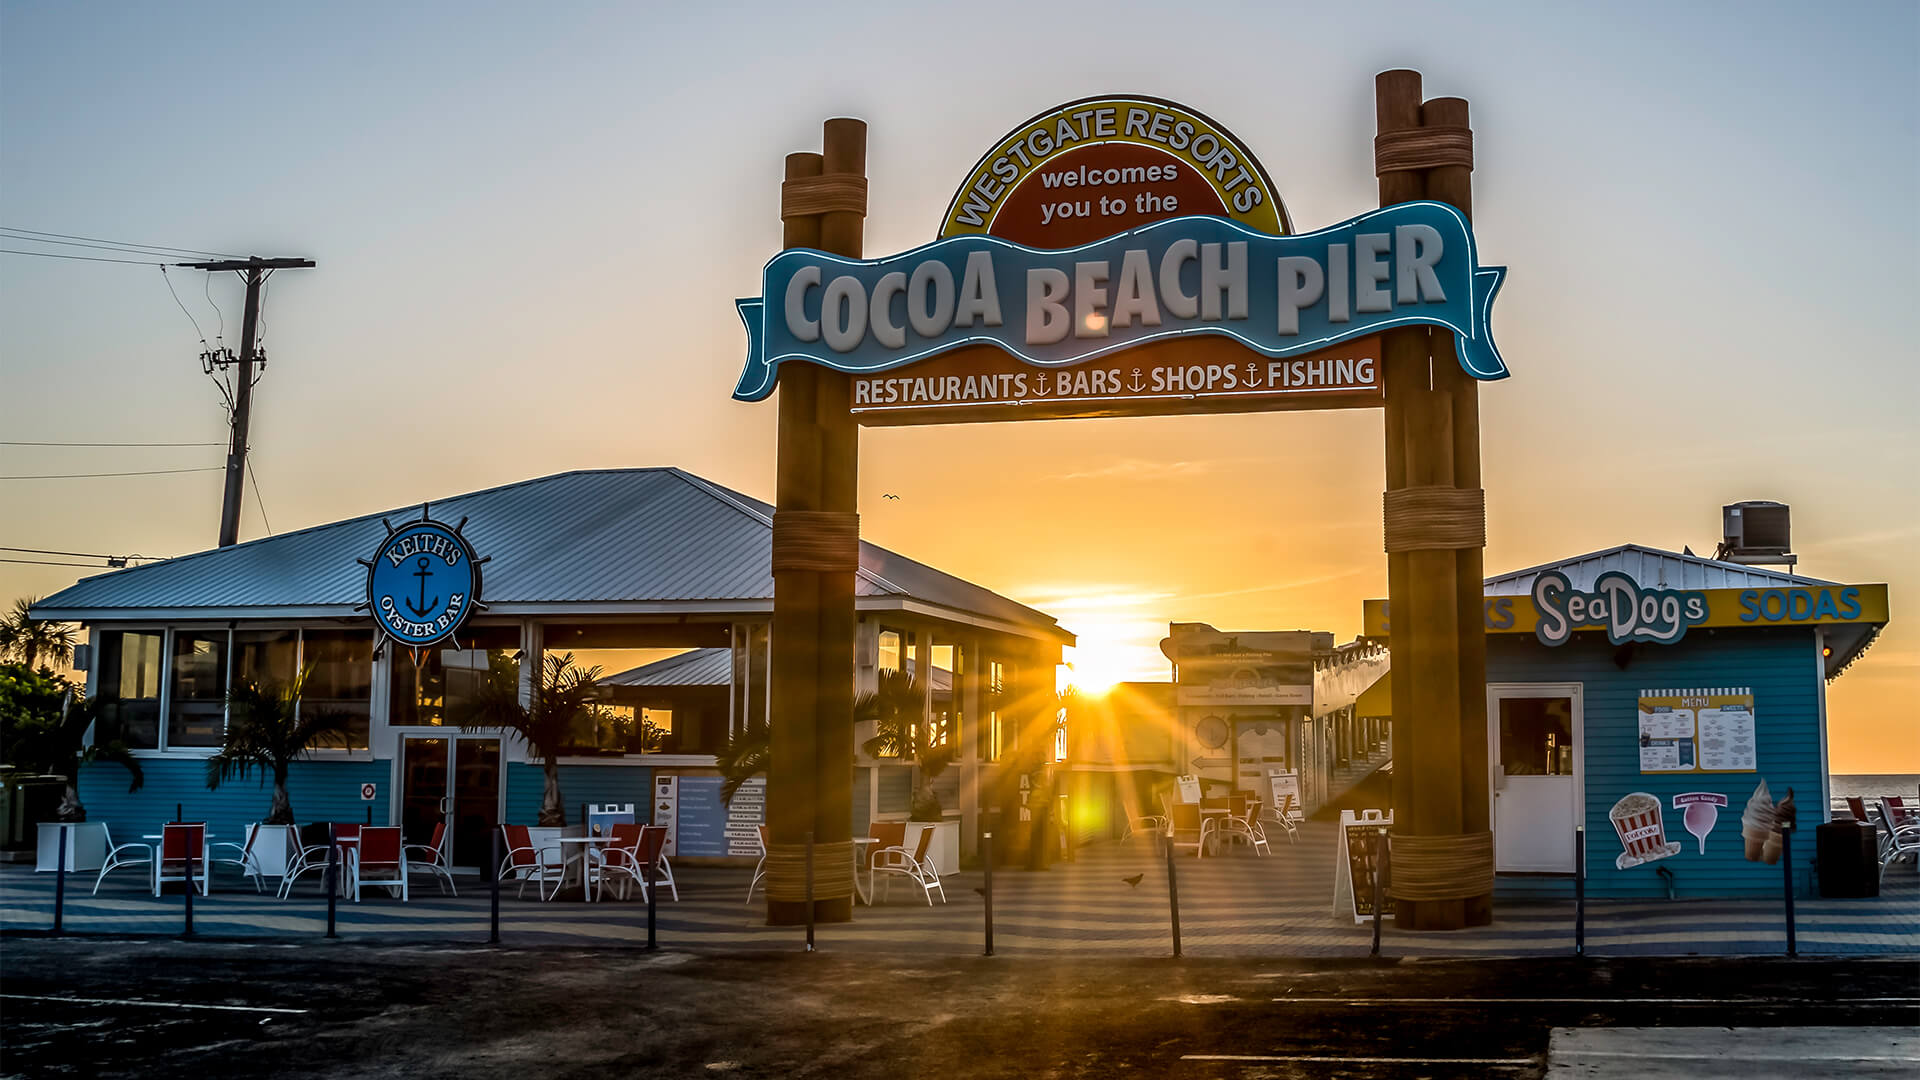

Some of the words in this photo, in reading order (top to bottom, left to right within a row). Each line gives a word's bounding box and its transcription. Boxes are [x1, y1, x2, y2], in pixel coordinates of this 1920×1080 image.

[955, 108, 1116, 227] WESTGATE
[1124, 108, 1262, 214] RESORTS
[1041, 164, 1178, 188] welcomes
[1041, 200, 1091, 225] you
[1100, 194, 1127, 215] to
[1135, 191, 1178, 213] the
[784, 251, 1003, 353] COCOA
[1025, 238, 1248, 345] BEACH
[1277, 223, 1447, 337] PIER
[855, 373, 1028, 404] RESTAURANTS
[1056, 369, 1121, 395] BARS
[1151, 364, 1238, 392] SHOPS
[1267, 358, 1375, 387] FISHING
[385, 534, 462, 567] KEITH'S
[381, 596, 436, 637] OYSTER
[437, 593, 464, 630] BAR
[1740, 587, 1862, 622] SODAS
[1681, 697, 1709, 707] MENU
[1019, 774, 1031, 821] ATM
